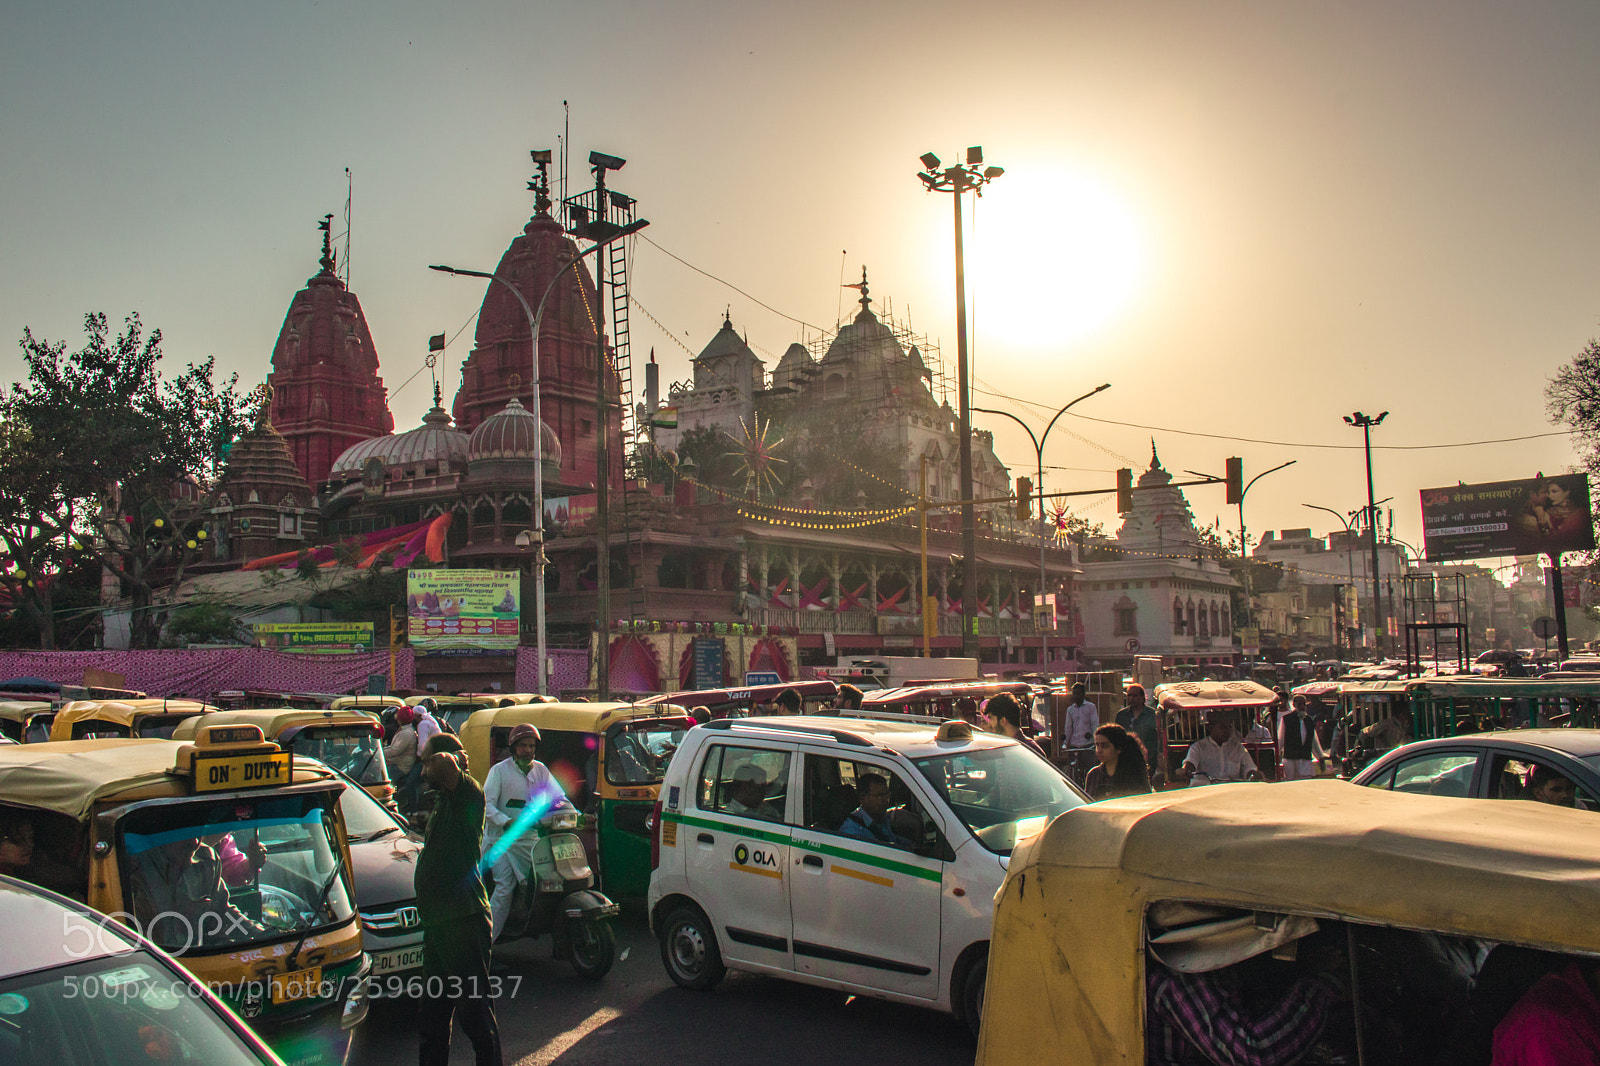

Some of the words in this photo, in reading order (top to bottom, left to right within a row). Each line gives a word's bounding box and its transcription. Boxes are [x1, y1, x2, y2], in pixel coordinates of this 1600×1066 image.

[726, 690, 752, 700] Yatri
[208, 765, 230, 784] ON
[244, 760, 282, 780] DUTY
[753, 849, 777, 867] OLA
[381, 955, 395, 970] DL
